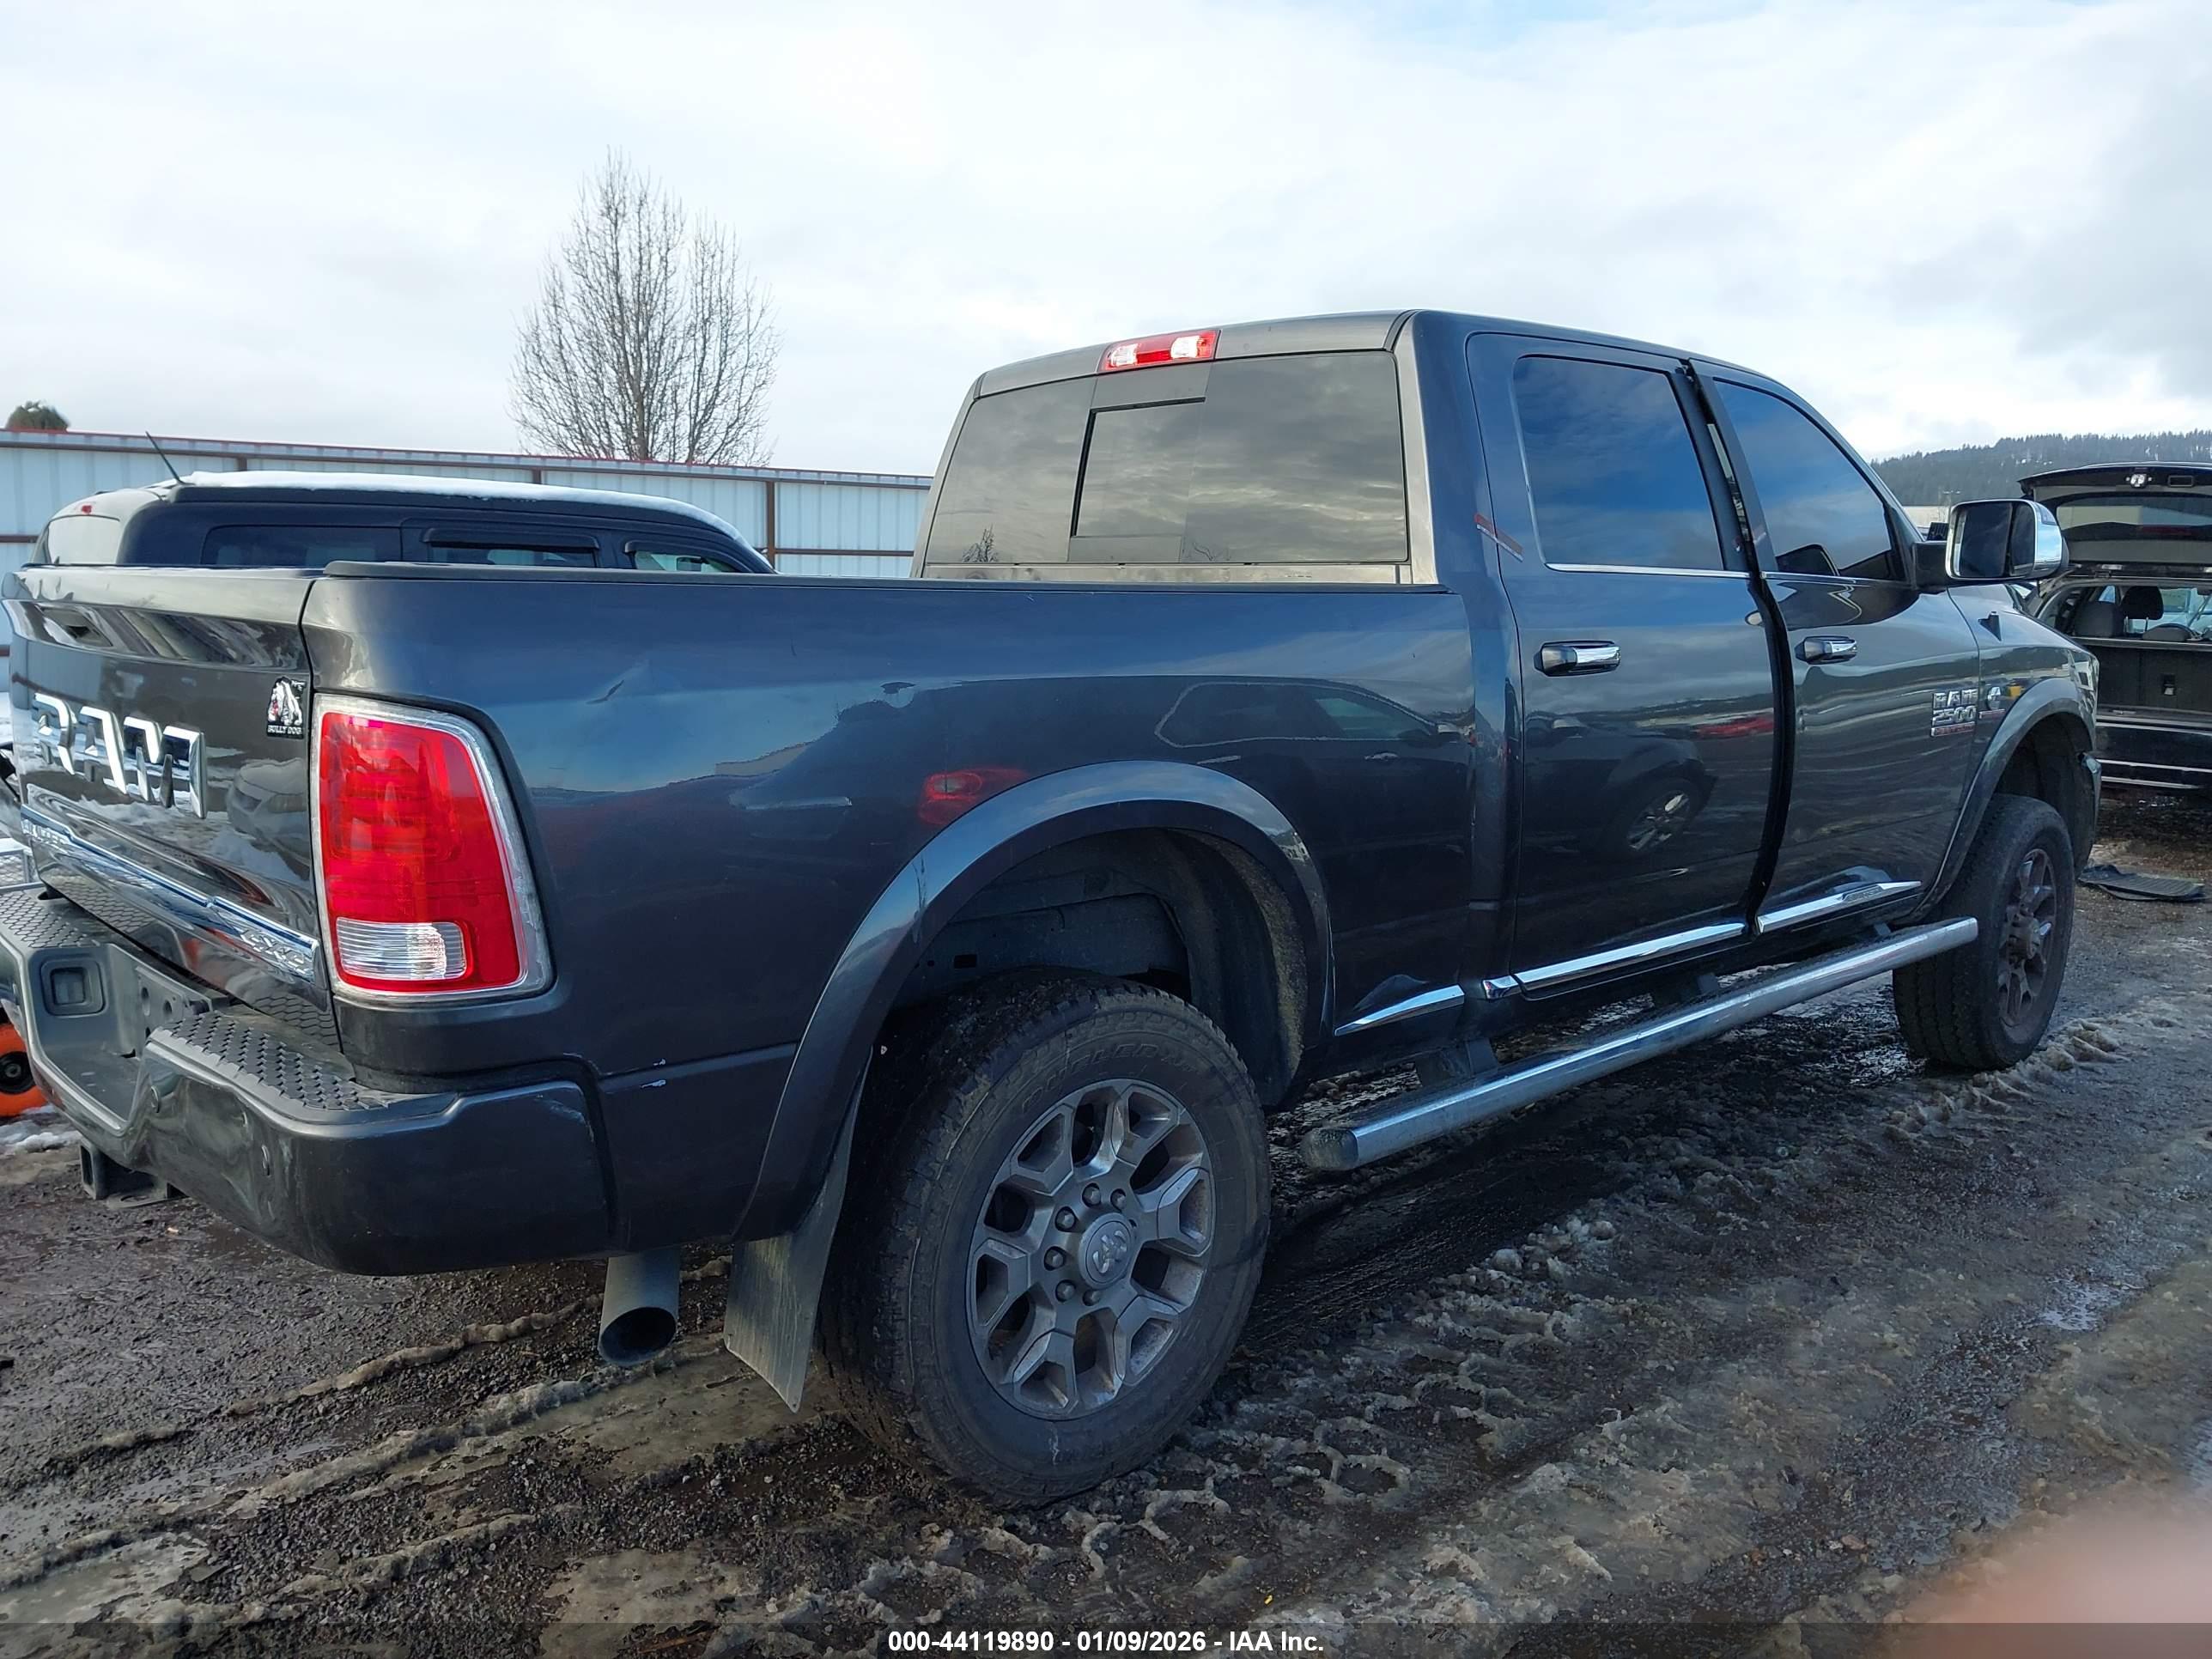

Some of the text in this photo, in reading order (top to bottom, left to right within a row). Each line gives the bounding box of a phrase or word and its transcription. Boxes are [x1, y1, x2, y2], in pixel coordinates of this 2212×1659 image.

[1934, 688, 1978, 708] RAM
[1932, 705, 1977, 725] 2500
[267, 724, 302, 736] BULLY DOG
[32, 692, 206, 819] RAM
